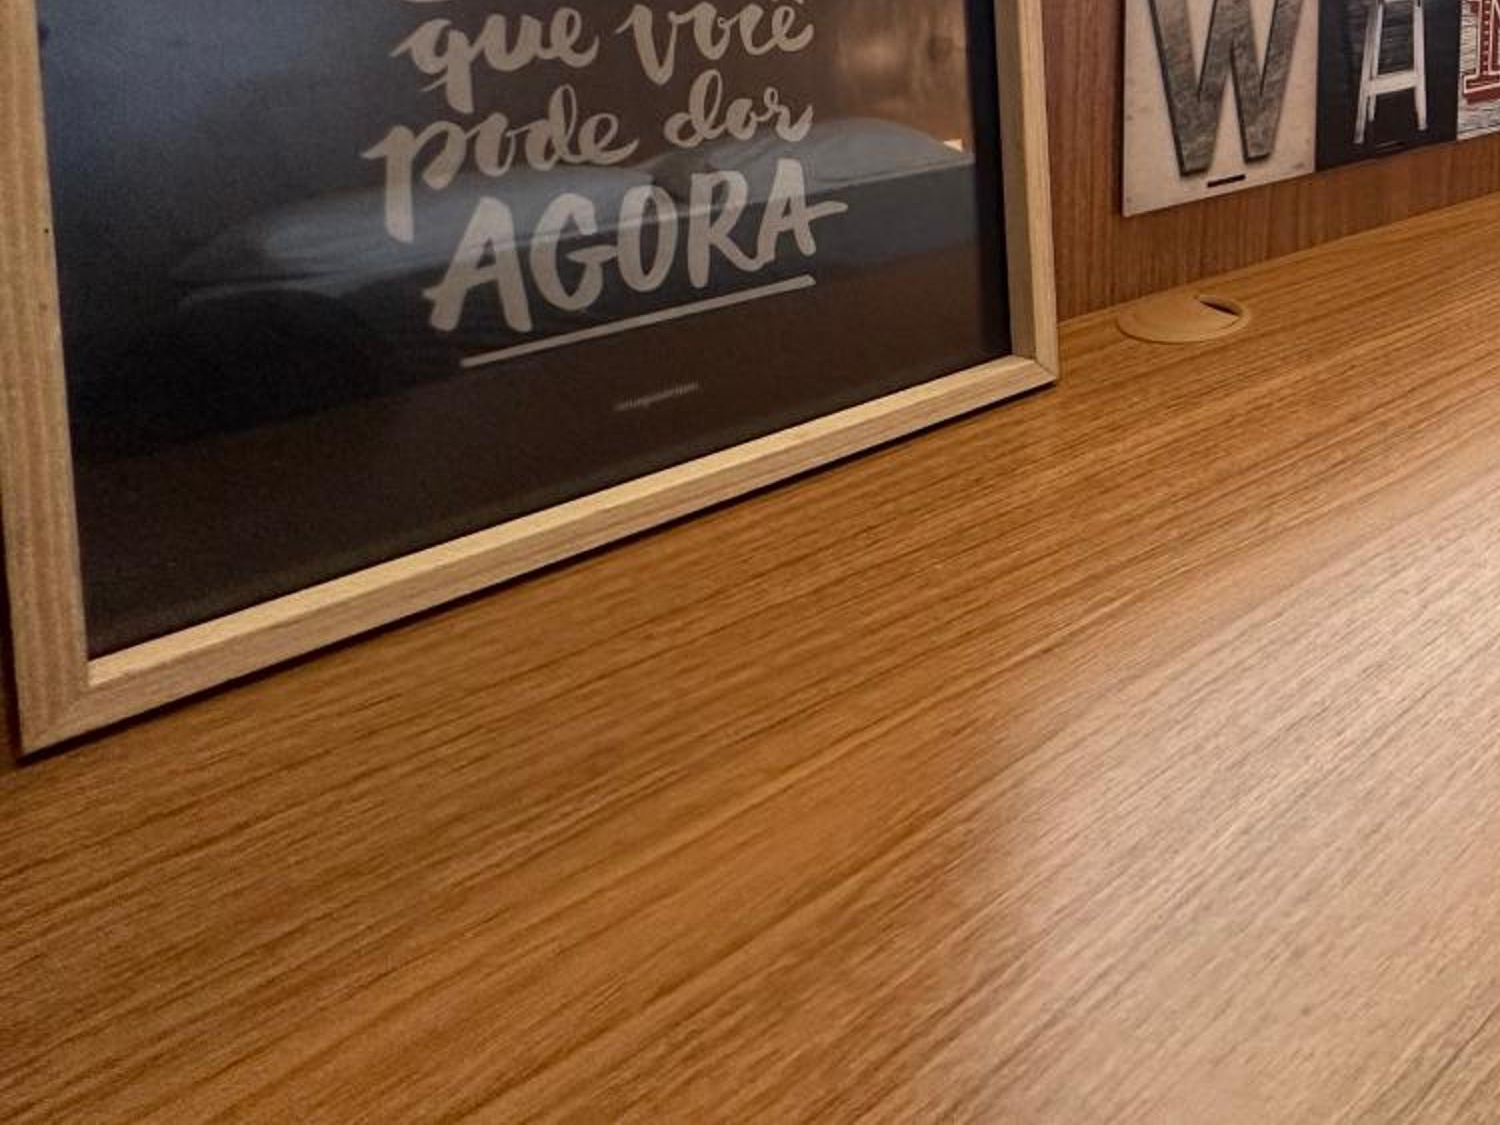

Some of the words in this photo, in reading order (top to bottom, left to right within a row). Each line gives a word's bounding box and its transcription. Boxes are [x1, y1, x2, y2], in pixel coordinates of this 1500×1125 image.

[391, 6, 598, 113] que
[362, 85, 637, 242] pode
[423, 161, 848, 332] AGORA
